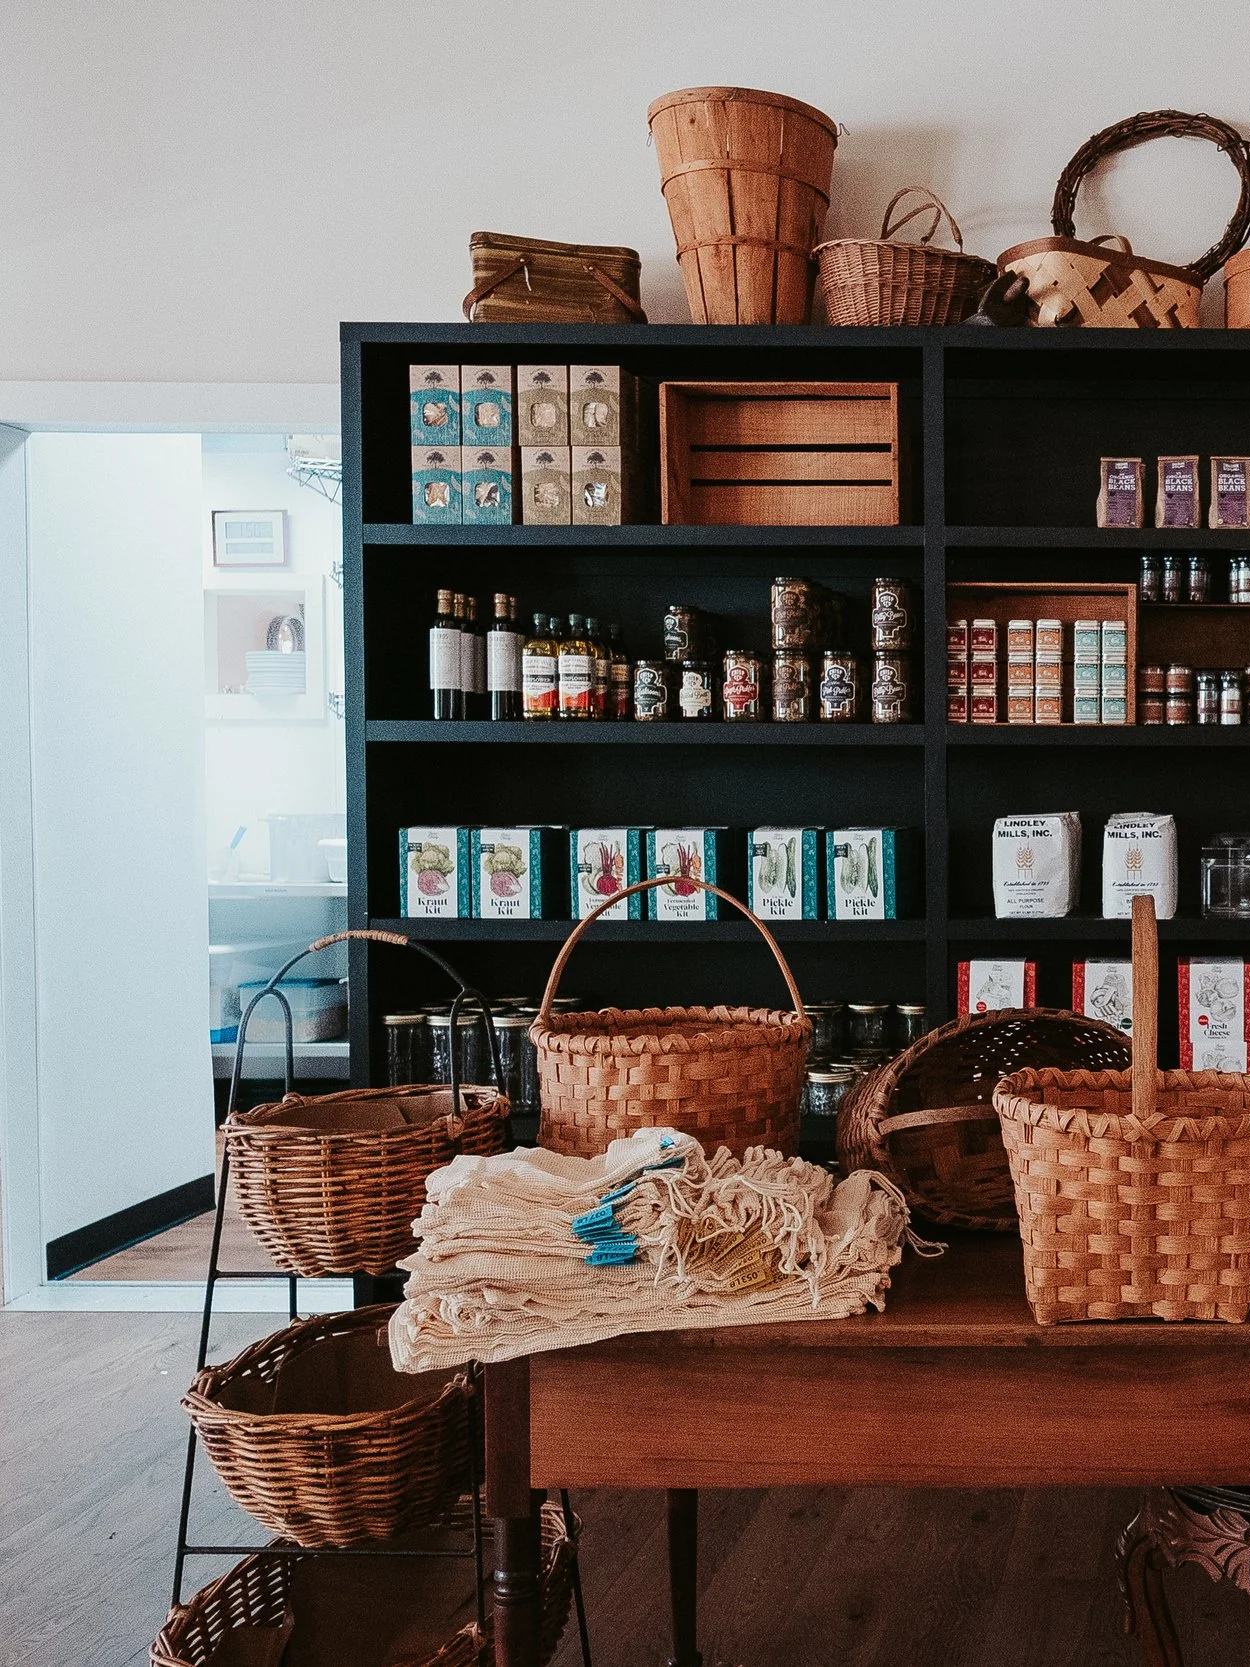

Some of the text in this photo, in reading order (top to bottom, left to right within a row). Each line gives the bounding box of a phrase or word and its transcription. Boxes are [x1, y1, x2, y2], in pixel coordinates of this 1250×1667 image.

[998, 829, 1053, 839] MILLS, INC.
[1107, 831, 1139, 840] MILLS,
[417, 897, 448, 906] Kraut
[490, 898, 520, 907] Kraut
[762, 898, 794, 907] Pickle
[845, 898, 876, 907] Pickle
[425, 906, 441, 914] Kit
[497, 907, 513, 915] Kit
[663, 903, 700, 912] Vegetable
[770, 907, 786, 915] Kit
[853, 907, 868, 915] Kit
[729, 1277, 741, 1289] LB
